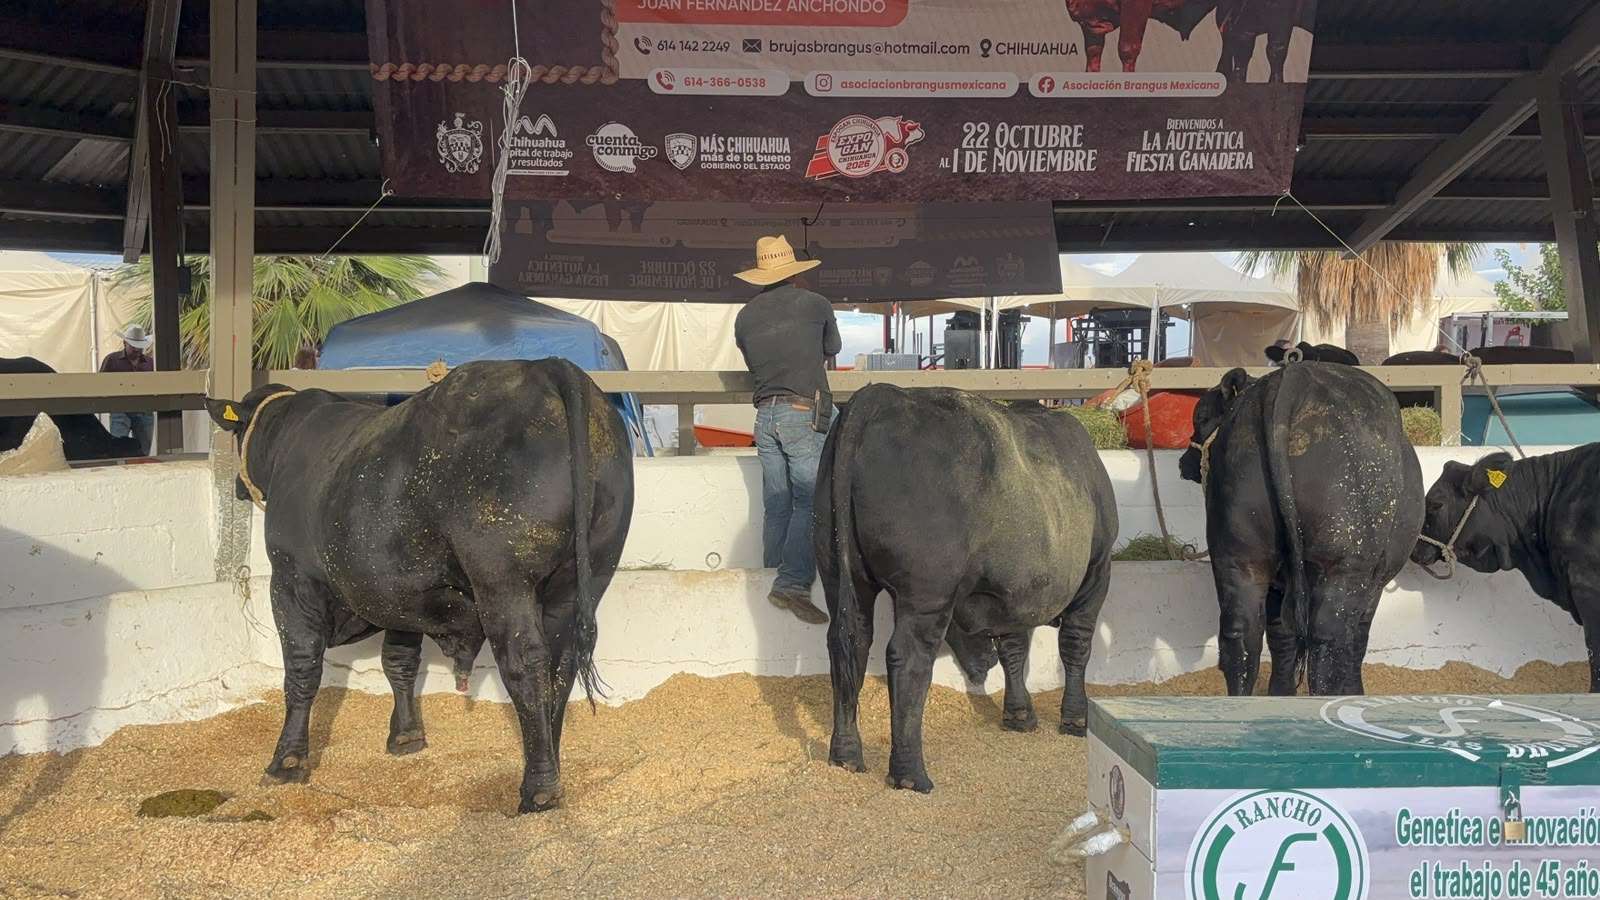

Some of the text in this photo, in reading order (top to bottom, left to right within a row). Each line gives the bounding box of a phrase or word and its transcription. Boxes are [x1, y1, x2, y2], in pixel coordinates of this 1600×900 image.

[786, 0, 887, 13] ANCHONDO
[656, 39, 731, 52] 614 142 2249
[768, 38, 971, 56] brujasbrangus@hotmail.com
[995, 42, 1079, 56] CHIHUAHUA
[683, 76, 766, 88] 614-366-0538
[840, 79, 1007, 92] asociacionbrangusmexicana
[1062, 79, 1221, 93] Asociación Brangus Mexicana
[1166, 118, 1224, 130] BIENVENIDOS A
[586, 133, 641, 147] cuenta
[836, 131, 874, 147] EXPO
[961, 121, 1084, 149] 22 OCTUBRE
[1142, 130, 1161, 151] LA
[700, 133, 791, 154] MÁS CHIHUAHUA
[840, 141, 874, 156] GAN
[509, 148, 574, 160] pital de trabajo
[596, 145, 657, 159] conmigo
[700, 150, 792, 163] más de lo bueno
[838, 152, 876, 164] CHIHUAHUA
[511, 158, 564, 168] y resultados
[700, 162, 742, 170] GOBIERNO
[846, 160, 870, 171] 2026
[939, 157, 951, 169] AL
[964, 150, 988, 173] DE
[992, 147, 1098, 173] NOVIEMBRE
[1126, 150, 1254, 172] FIESTA GANADERA
[1233, 797, 1322, 829] RANCHO
[1397, 807, 1600, 845] Genetica e novació
[1410, 861, 1600, 900] el trabajo de 45 año
